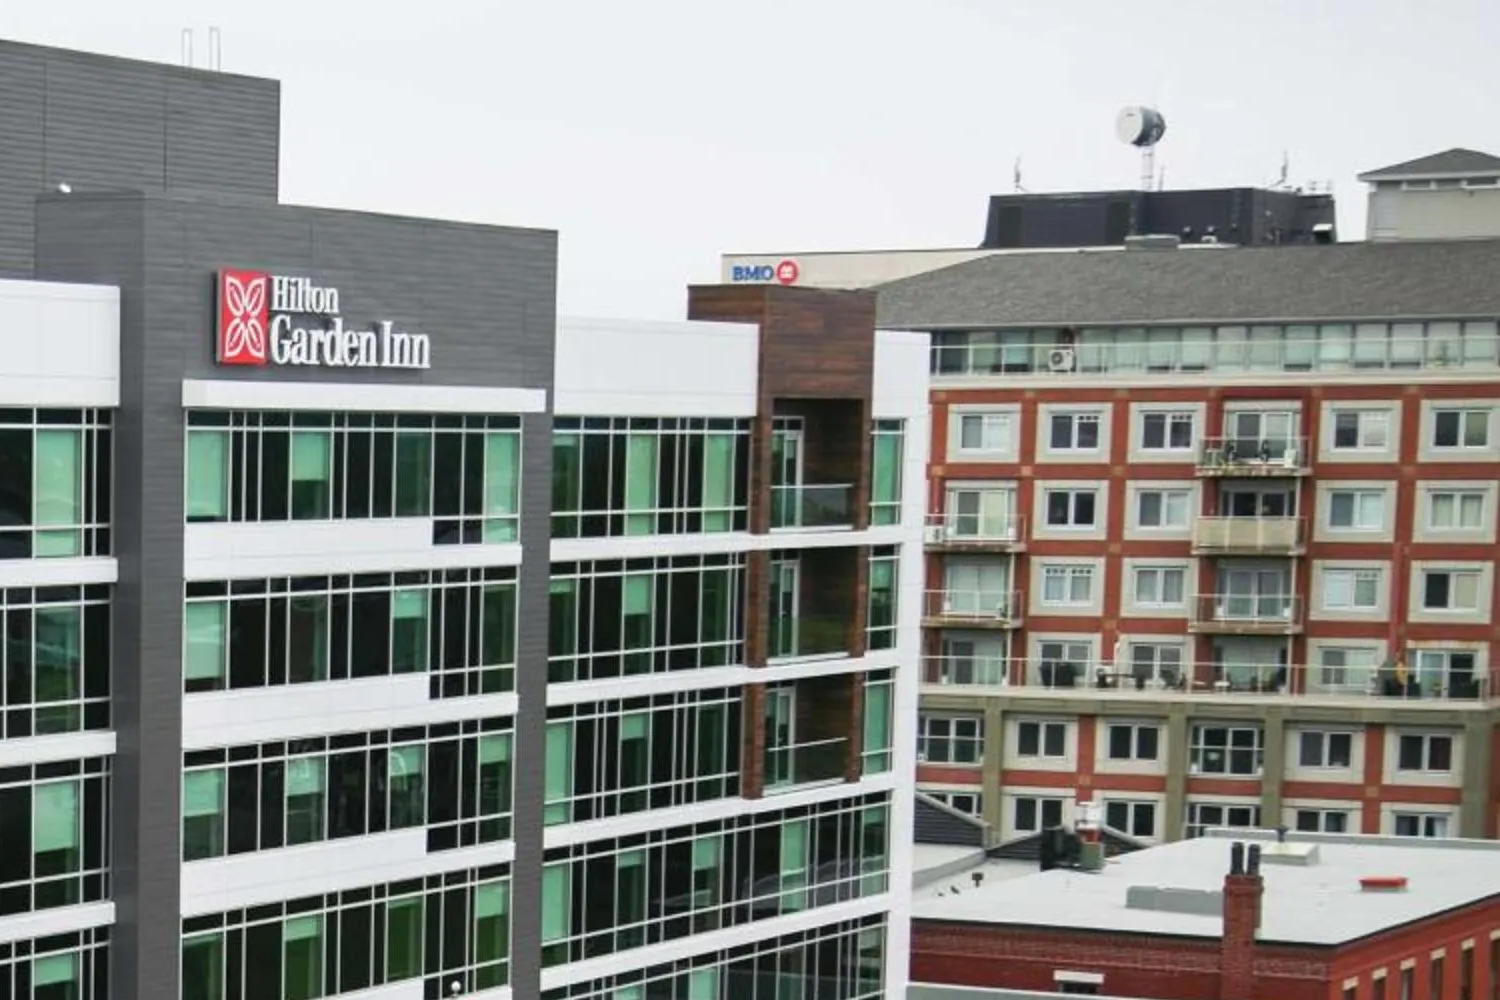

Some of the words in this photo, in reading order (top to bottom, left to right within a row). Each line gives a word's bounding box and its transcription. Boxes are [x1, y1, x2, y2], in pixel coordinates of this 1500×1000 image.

[732, 265, 774, 281] BMO
[271, 275, 339, 313] Hilton
[270, 315, 378, 366] Garden
[380, 321, 431, 369] Inn
